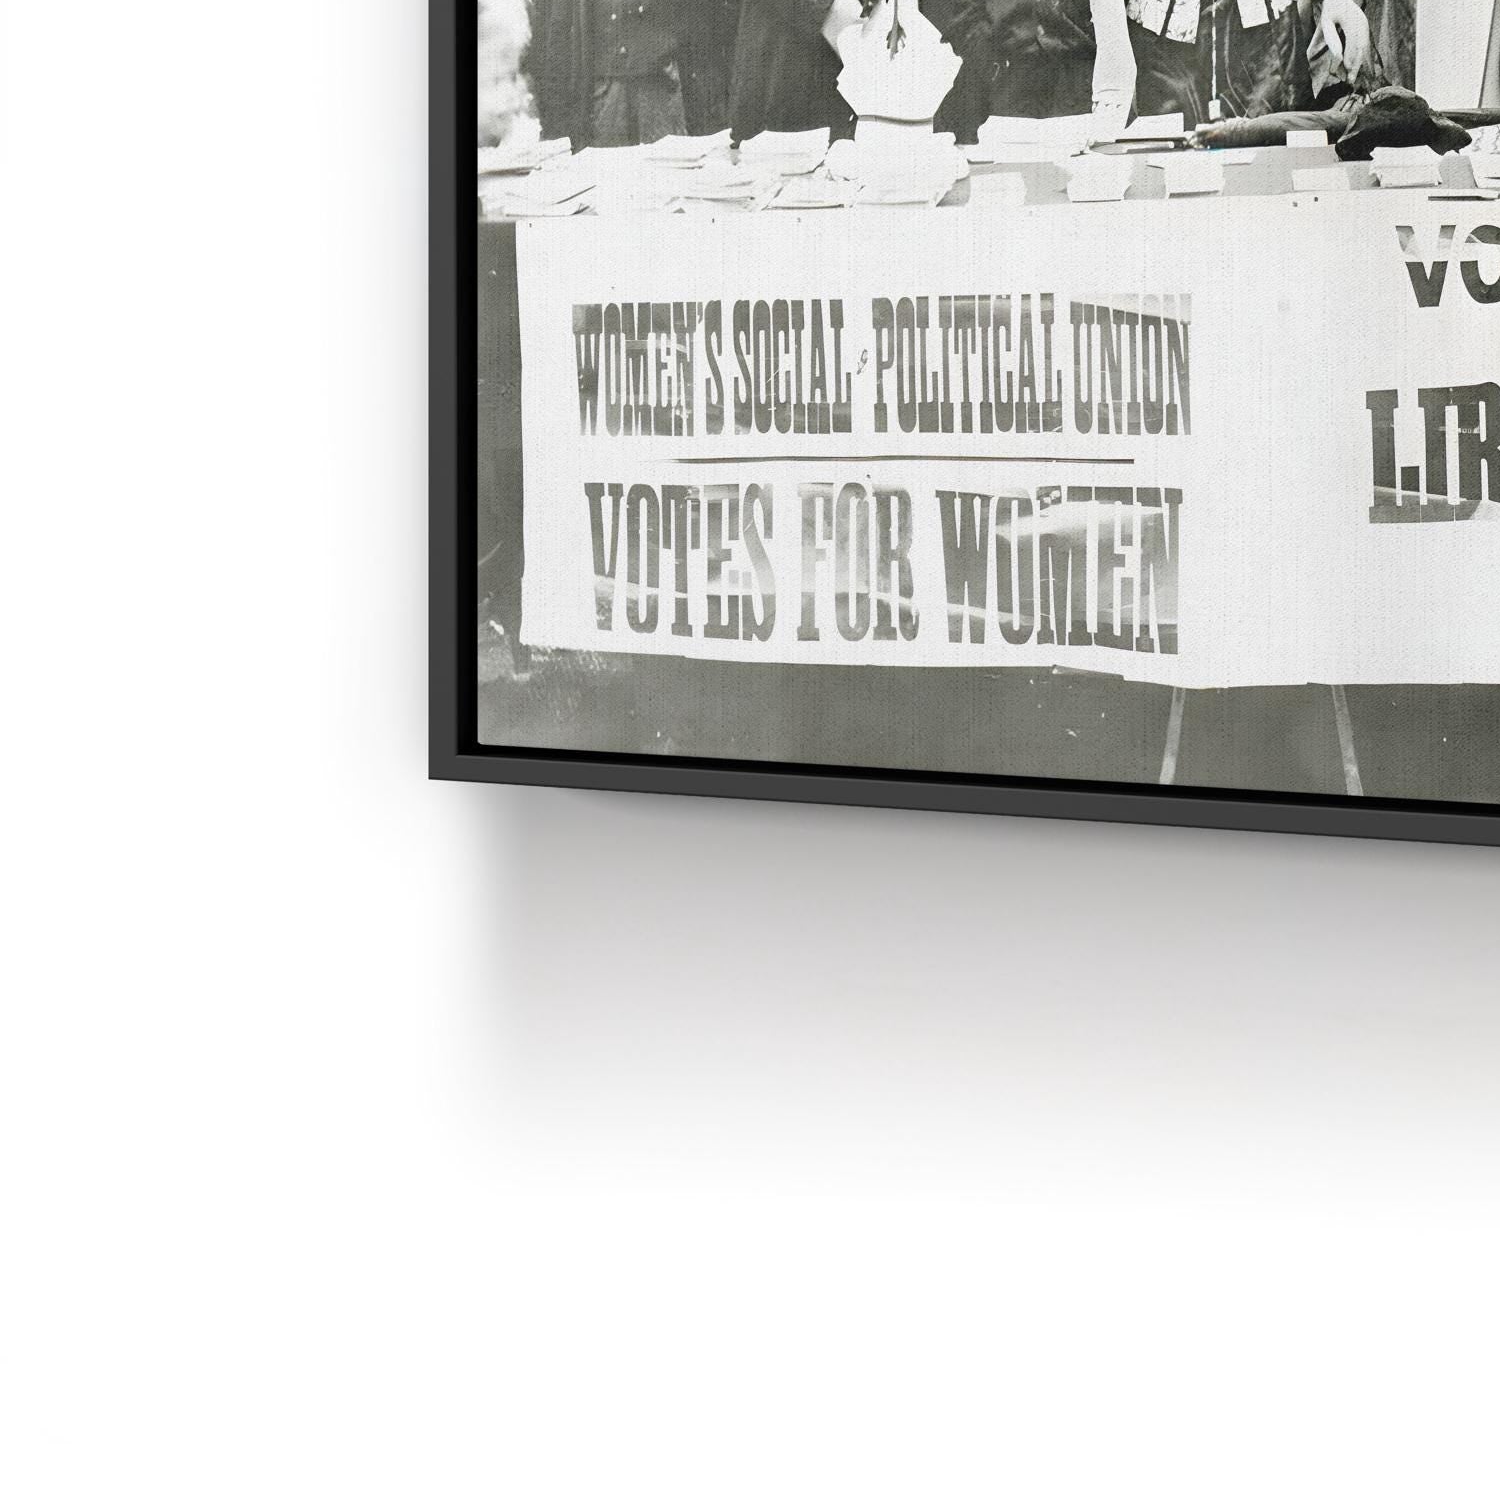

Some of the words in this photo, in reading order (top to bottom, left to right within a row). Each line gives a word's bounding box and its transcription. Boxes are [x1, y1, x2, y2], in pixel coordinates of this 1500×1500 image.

[572, 299, 724, 438] WOMEN'S
[734, 298, 852, 435] SOCIAL
[872, 292, 1062, 435] POLITICAL
[1070, 292, 1192, 436] UNION
[584, 482, 776, 643] VOTES
[797, 482, 920, 642] FOR
[934, 485, 1183, 655] WOMEN
